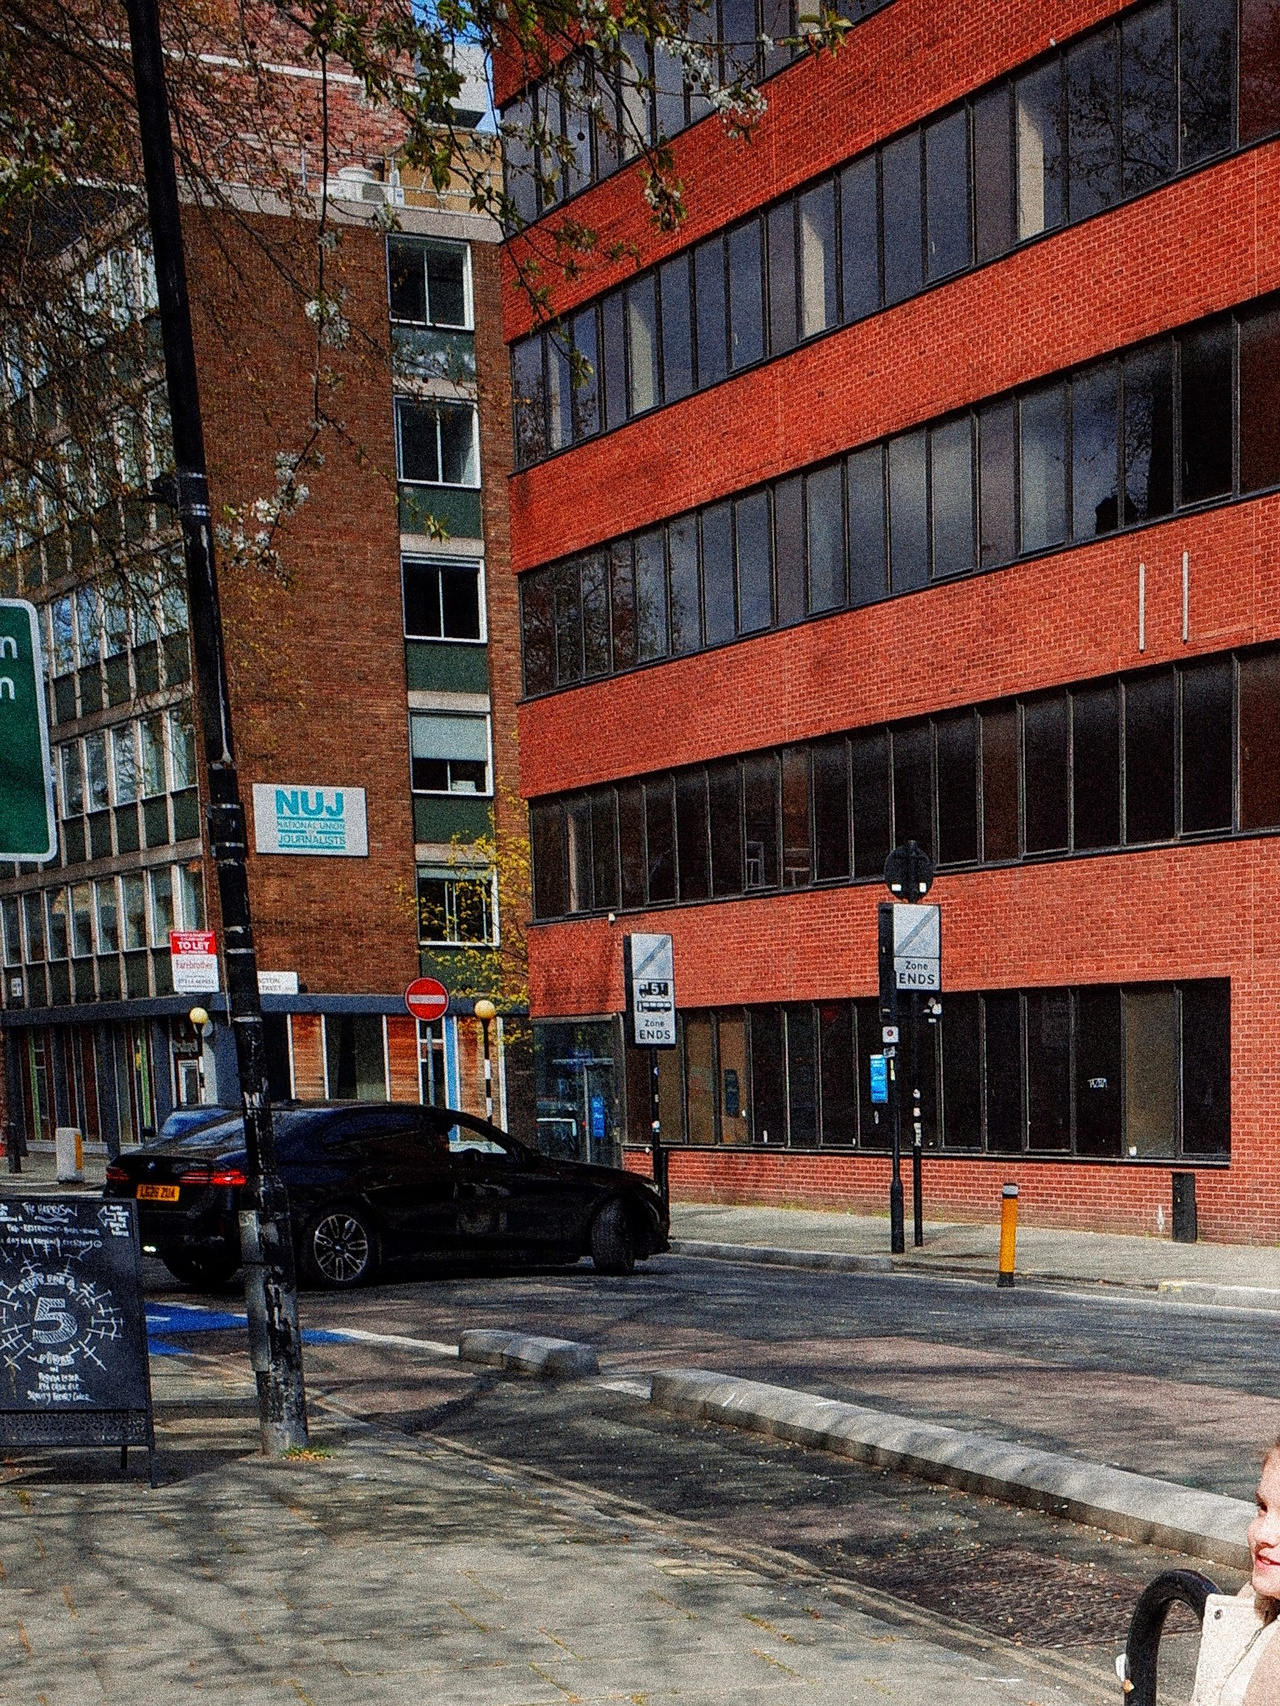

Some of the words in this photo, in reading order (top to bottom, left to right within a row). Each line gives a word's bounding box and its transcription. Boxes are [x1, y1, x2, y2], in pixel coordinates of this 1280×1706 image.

[275, 788, 345, 817] NUJ
[277, 820, 316, 830] NATIONAL
[279, 834, 346, 846] JOURNALISTS
[177, 941, 191, 951] TO
[192, 941, 211, 951] LET
[905, 960, 929, 971] Zone
[899, 973, 935, 985] ENDS
[645, 1019, 664, 1028] Zone
[639, 1029, 671, 1040] ENDS
[32, 1296, 78, 1344] 5
